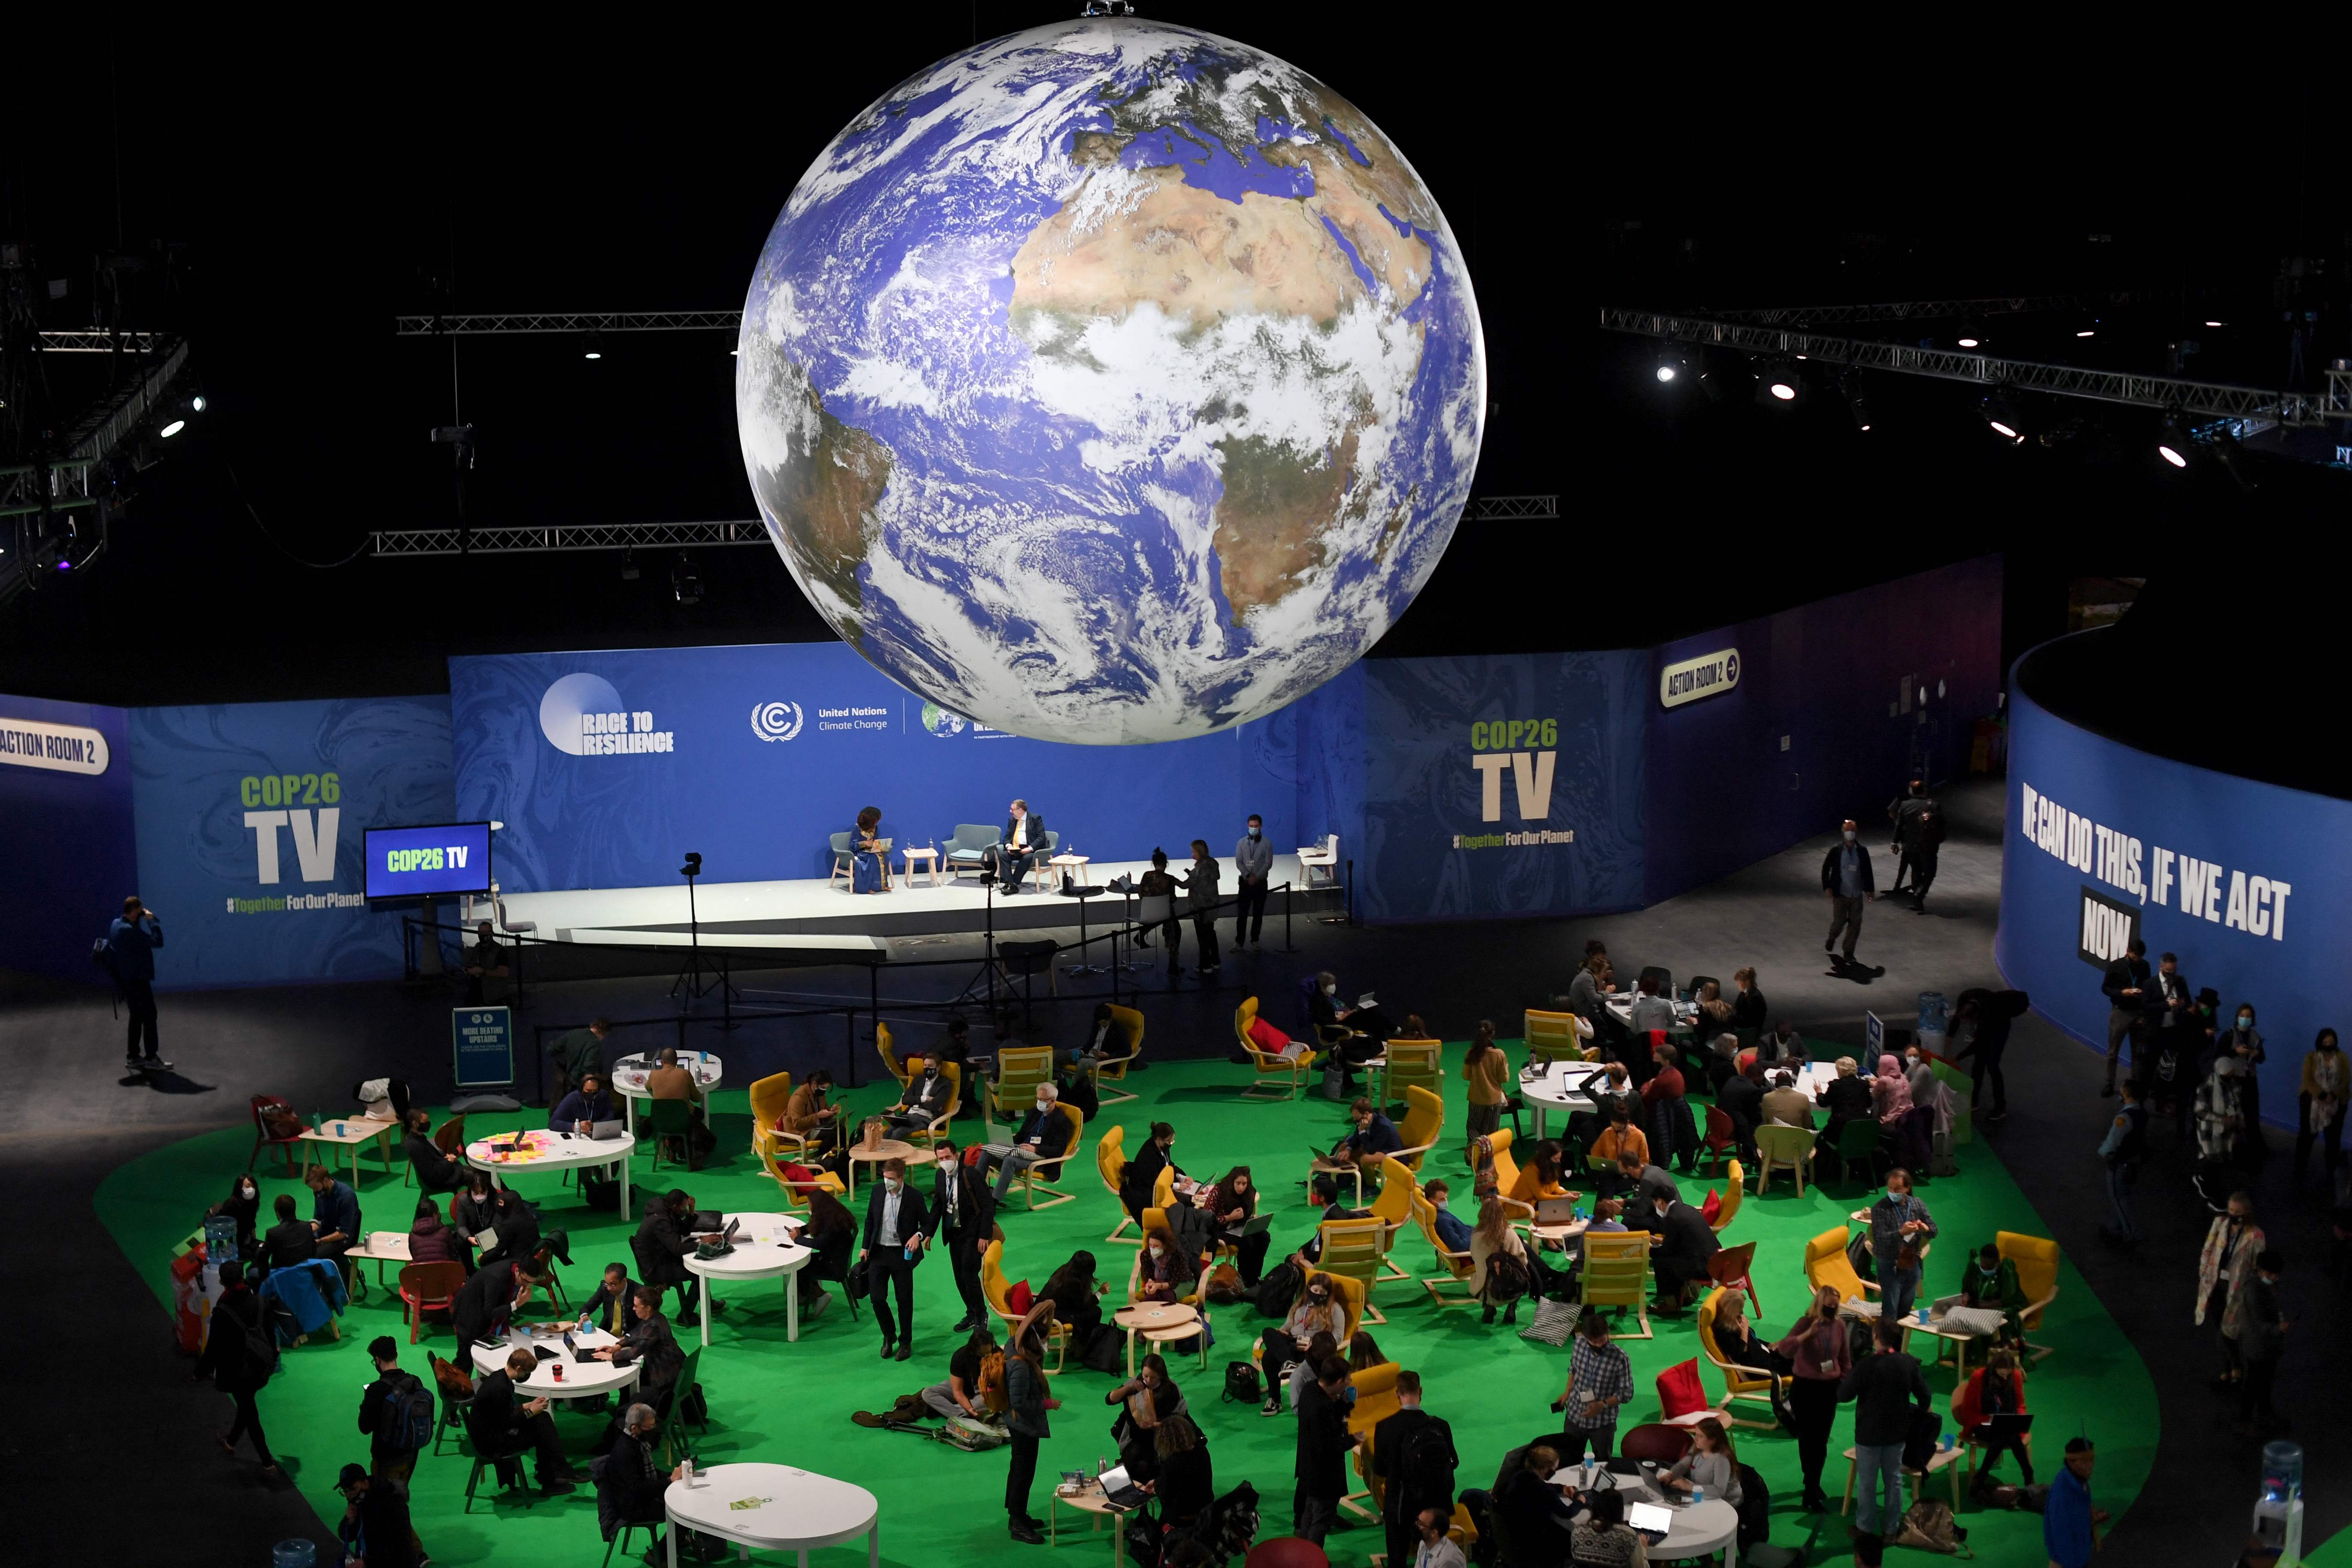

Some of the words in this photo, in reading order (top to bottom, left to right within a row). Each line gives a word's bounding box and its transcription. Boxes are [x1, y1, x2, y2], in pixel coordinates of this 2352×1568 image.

[1668, 669, 1695, 697] ACTION
[1696, 663, 1717, 689] ROOM
[1718, 661, 1723, 682] 2
[583, 713, 627, 734] RACE
[632, 711, 653, 732] TO
[819, 708, 849, 717] United
[851, 707, 887, 717] Nations
[819, 721, 852, 730] Climate
[854, 720, 887, 730] Change
[0, 729, 43, 757] ACTION
[46, 735, 83, 762] ROOM
[86, 740, 95, 763] 2
[583, 732, 674, 755] RESILIENCE
[1471, 718, 1557, 750] COP26
[241, 773, 340, 807] COP26
[1473, 751, 1556, 822] TV
[244, 807, 340, 884] TV
[388, 848, 443, 872] COP26
[447, 846, 468, 869] TV
[2022, 782, 2038, 843] WE
[2037, 796, 2066, 861] CAN
[2067, 811, 2092, 873] DO
[2096, 824, 2147, 906] THIS,
[2151, 846, 2174, 906] IF
[2179, 854, 2222, 923] WE
[2225, 869, 2291, 941] ACT
[2083, 896, 2132, 962] NOW
[462, 1027, 478, 1035] MORE
[480, 1026, 503, 1035] SEATING
[469, 1035, 497, 1043] UPSTAIRS
